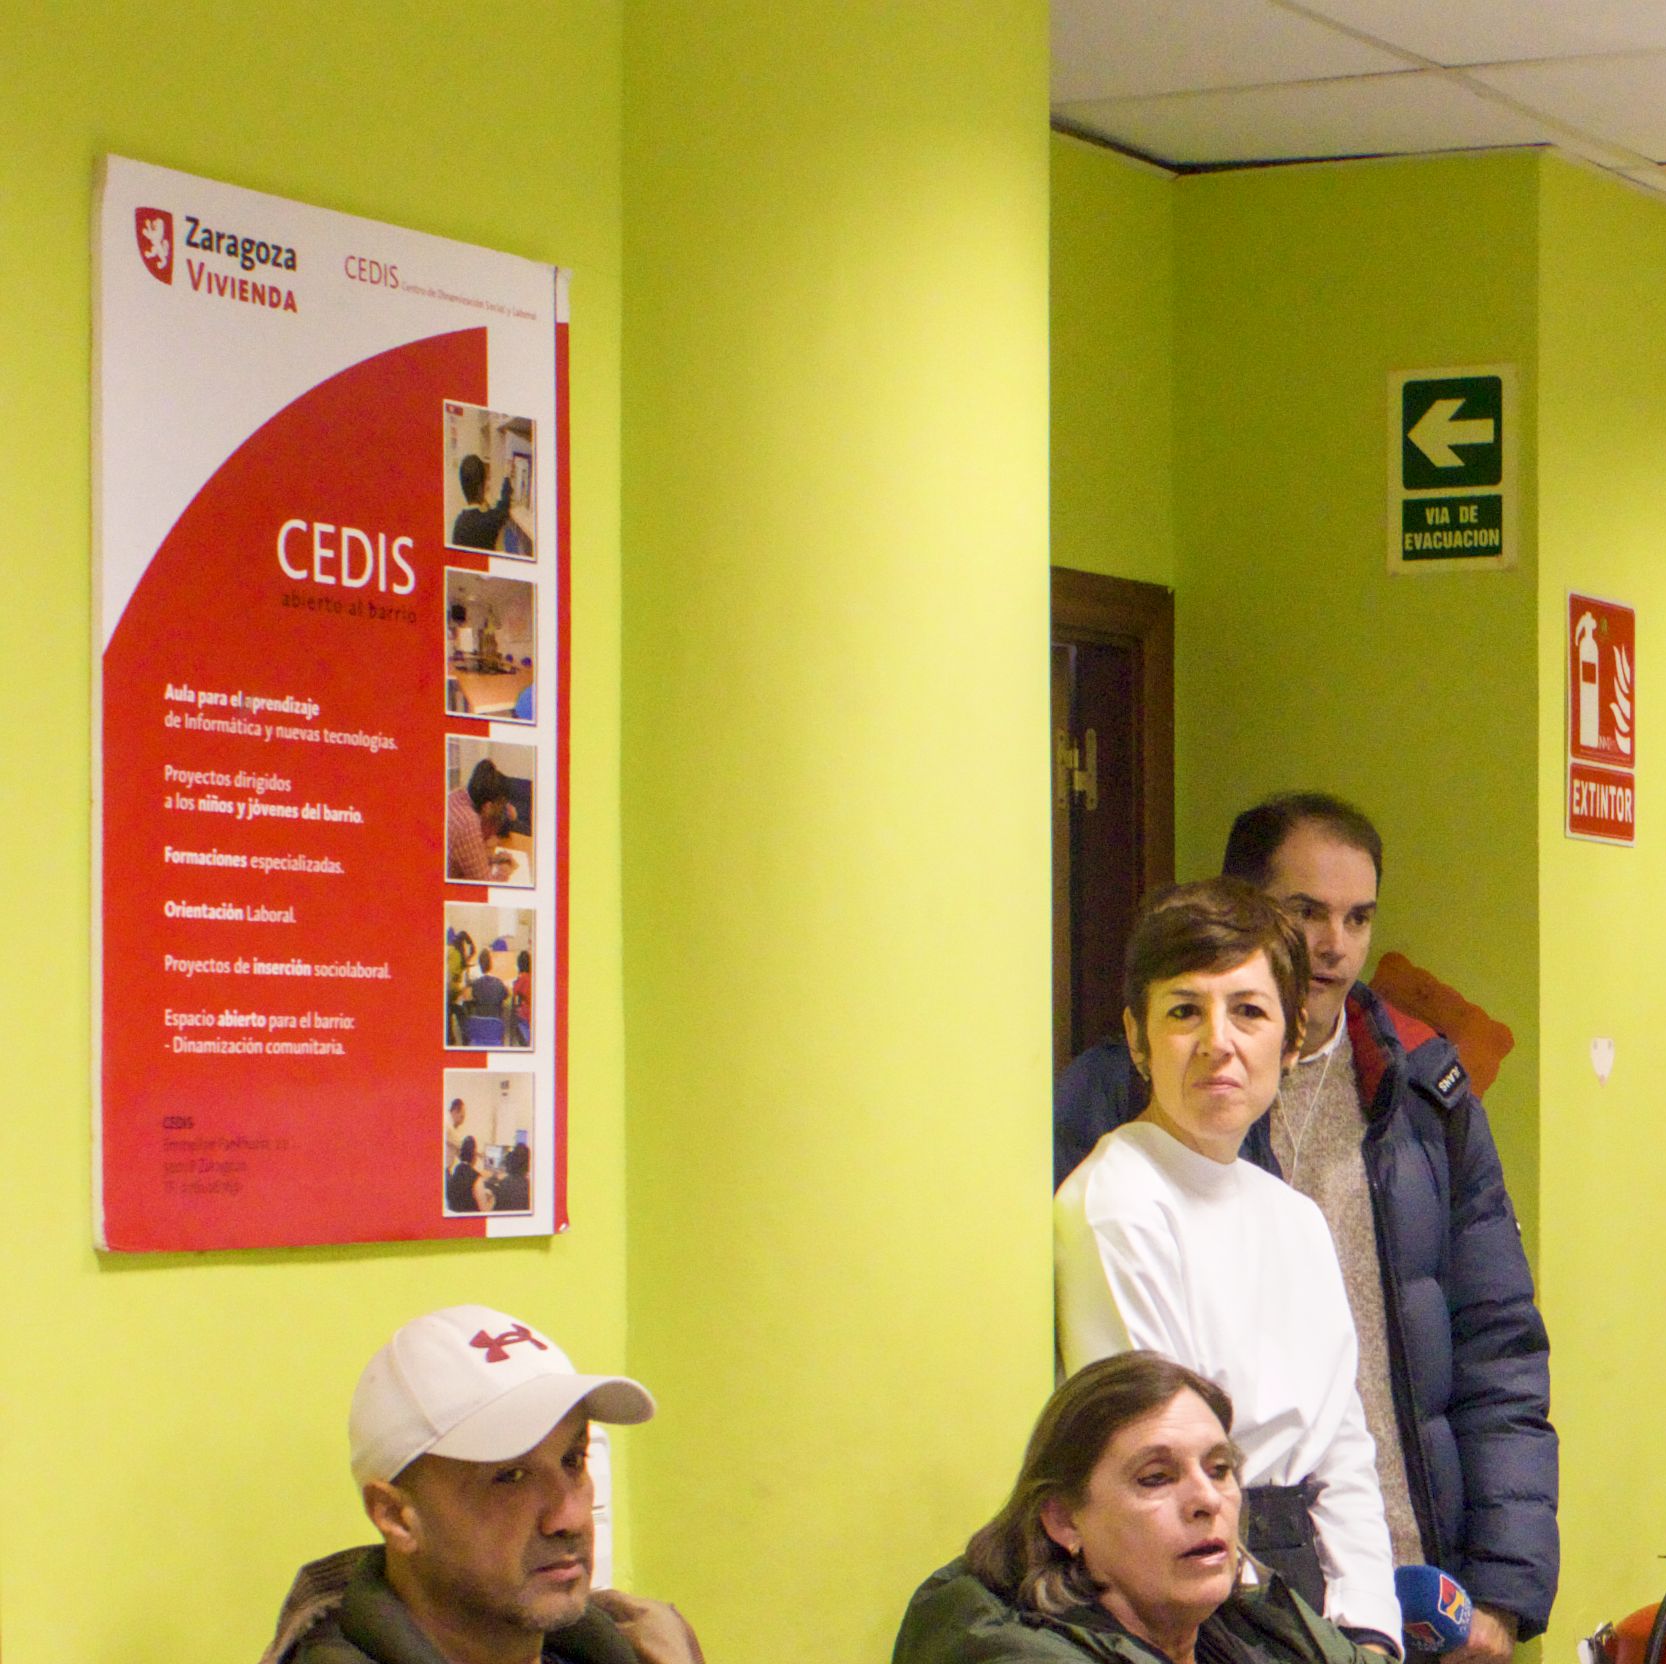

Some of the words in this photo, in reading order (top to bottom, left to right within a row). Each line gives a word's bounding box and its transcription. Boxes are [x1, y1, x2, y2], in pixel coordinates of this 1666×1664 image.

[185, 215, 298, 271] Zaragoza
[186, 258, 298, 314] VIVIENDA
[344, 255, 400, 290] CEDIS
[1425, 506, 1450, 525] VIA
[1459, 505, 1479, 523] DE
[1404, 528, 1500, 551] EVACUACION
[277, 518, 416, 595] CEDIS
[164, 683, 195, 703] Aula
[198, 690, 228, 708] para
[230, 691, 243, 708] el
[245, 695, 320, 720] aprendizaje
[164, 711, 181, 728] de
[185, 713, 262, 737] Informática
[264, 725, 273, 742] y
[276, 725, 321, 743] nuevas
[164, 764, 231, 788] Proyectos
[234, 770, 292, 794] dirigidos
[164, 796, 172, 810] a
[176, 792, 195, 811] los
[198, 793, 234, 814] niños
[236, 801, 246, 819] y
[247, 797, 299, 820] jóvenes
[301, 802, 321, 820] del
[323, 803, 364, 824] barrio.
[1573, 778, 1633, 823] EXTINTOR
[164, 846, 248, 868] Formaciones
[250, 854, 345, 874] especializadas.
[164, 900, 245, 921] Orientación
[247, 904, 297, 924] Laboral.
[164, 954, 231, 978] Proyectos
[234, 957, 250, 974] de
[253, 957, 312, 976] inserción
[314, 960, 392, 979] sociolaboral.
[164, 1008, 215, 1031] Espacio
[217, 1009, 267, 1028] abierto
[269, 1015, 297, 1032] para
[299, 1012, 311, 1029] el
[314, 1011, 355, 1030] barrio:
[172, 1035, 264, 1055] Dinamización
[265, 1038, 346, 1056] comunitaria.
